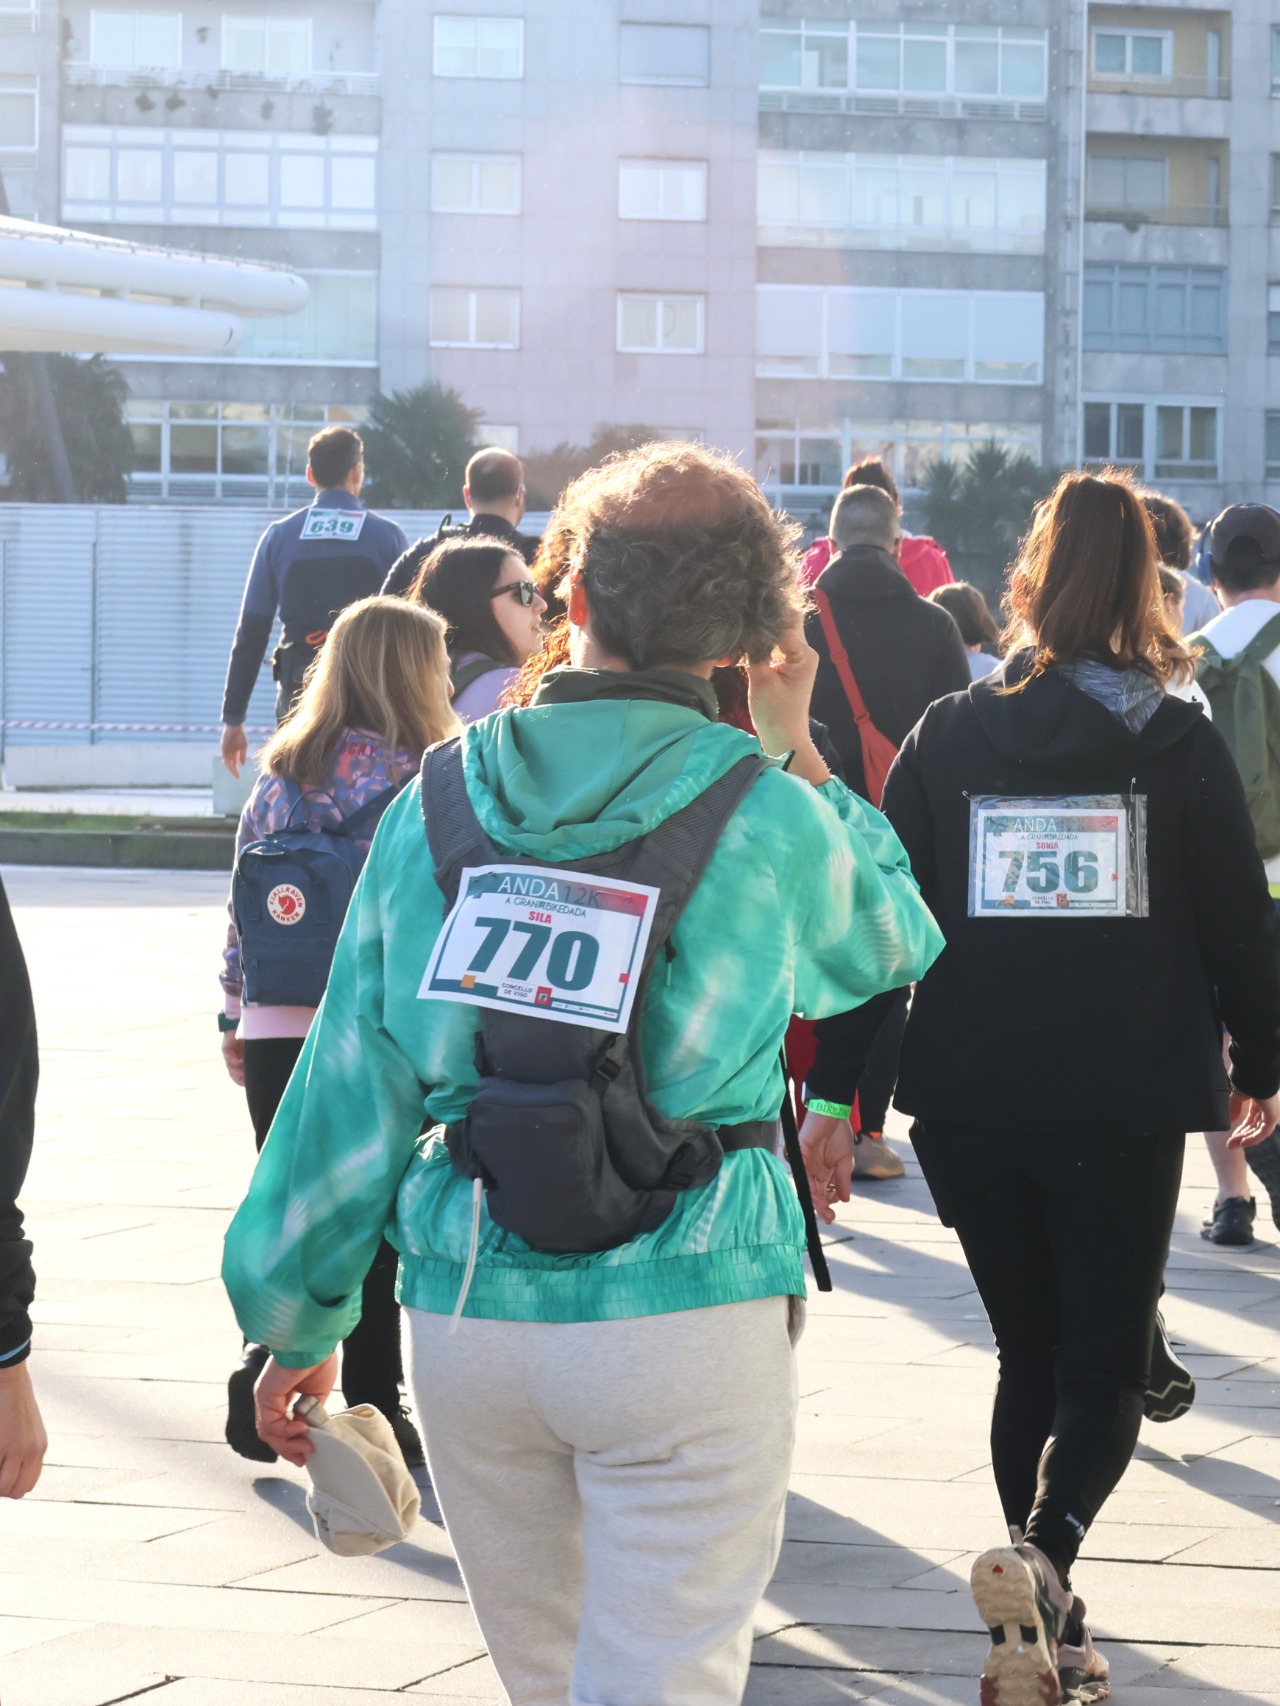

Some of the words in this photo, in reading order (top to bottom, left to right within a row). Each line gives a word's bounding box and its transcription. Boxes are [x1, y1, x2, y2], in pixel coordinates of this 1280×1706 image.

[310, 519, 355, 534] 639
[1013, 817, 1058, 833] ANDA
[998, 850, 1099, 894] 756
[497, 875, 560, 901] ANDA
[528, 910, 552, 925] SILA
[466, 916, 600, 991] 770
[501, 982, 533, 994] CONCELLO
[503, 988, 513, 996] DE
[513, 990, 529, 999] VIGO
